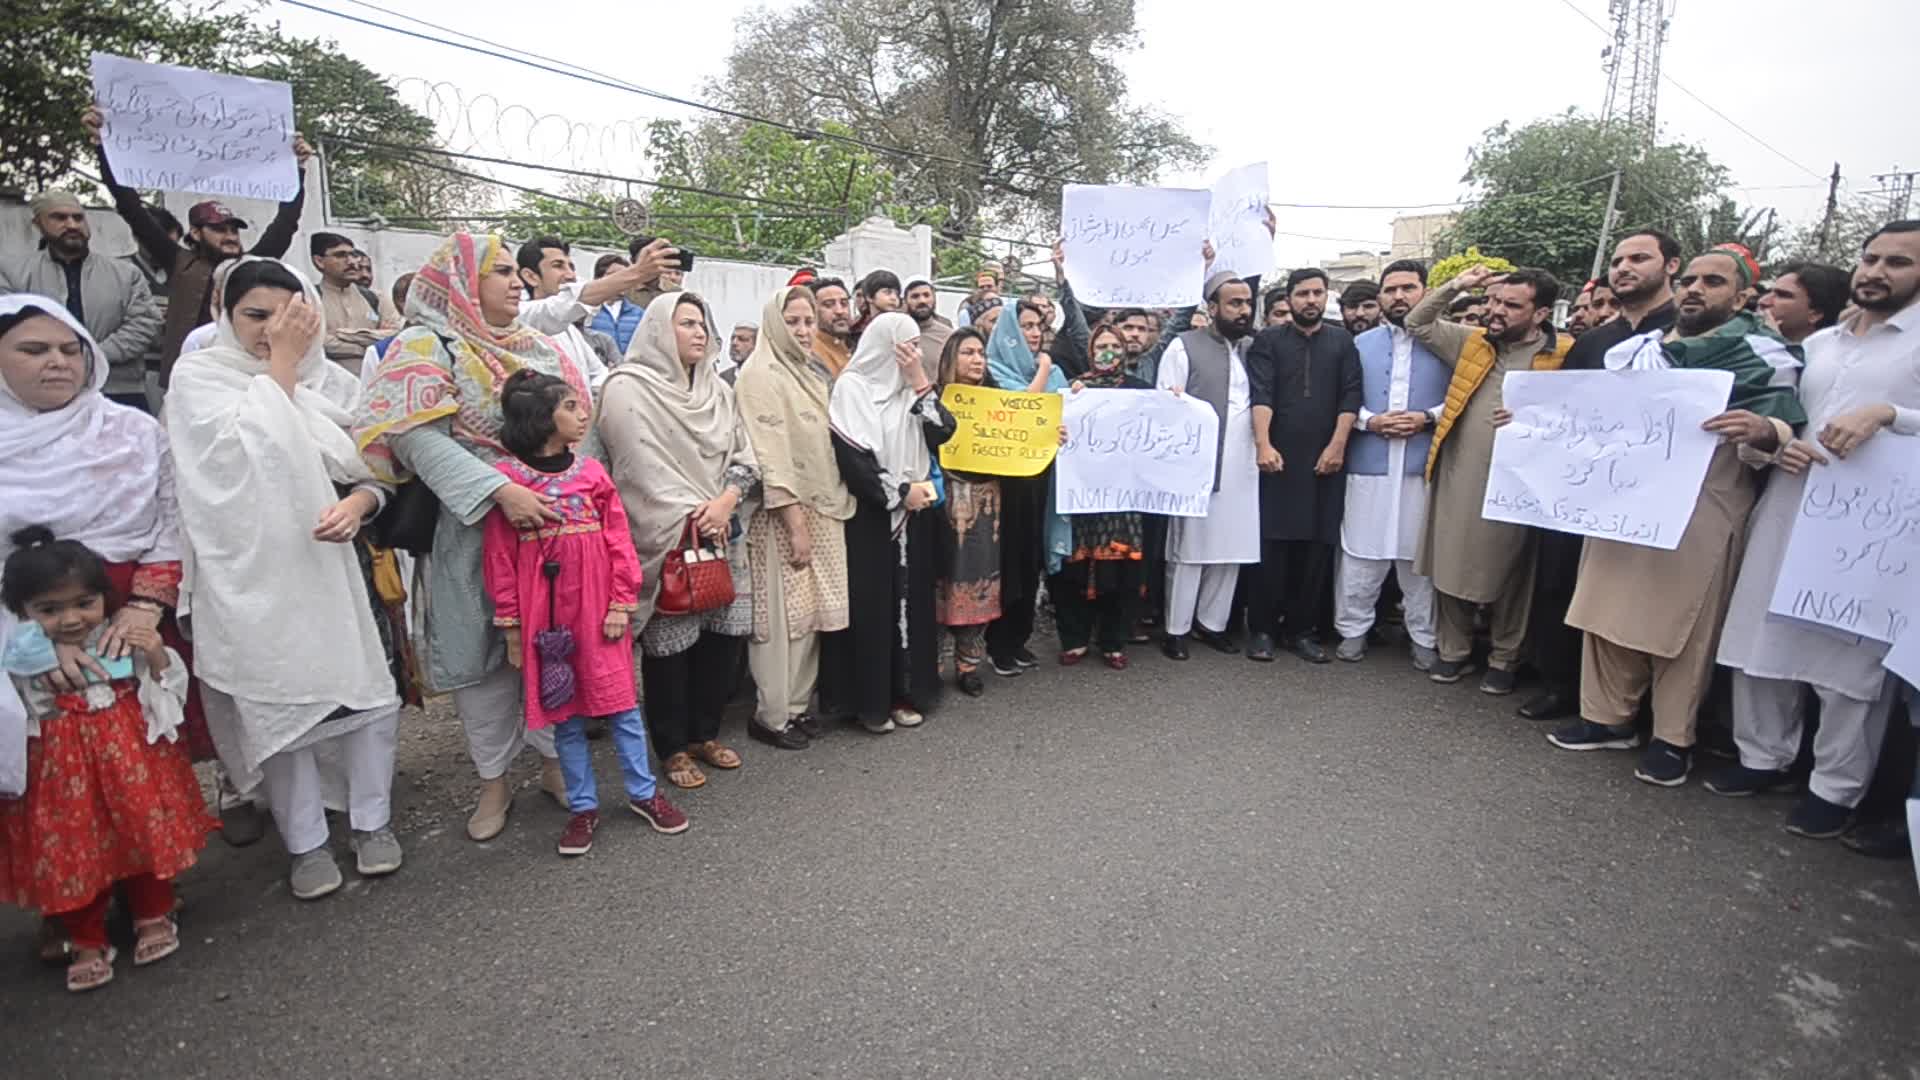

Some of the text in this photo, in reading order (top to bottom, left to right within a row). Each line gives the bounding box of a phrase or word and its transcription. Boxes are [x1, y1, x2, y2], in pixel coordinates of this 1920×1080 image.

[999, 397, 1044, 410] VOICES
[987, 410, 1016, 424] NOT
[972, 422, 1028, 442] SILENCED
[972, 443, 1014, 457] FASCIST
[1019, 447, 1049, 459] RULE
[1791, 588, 1872, 628] INSAF
